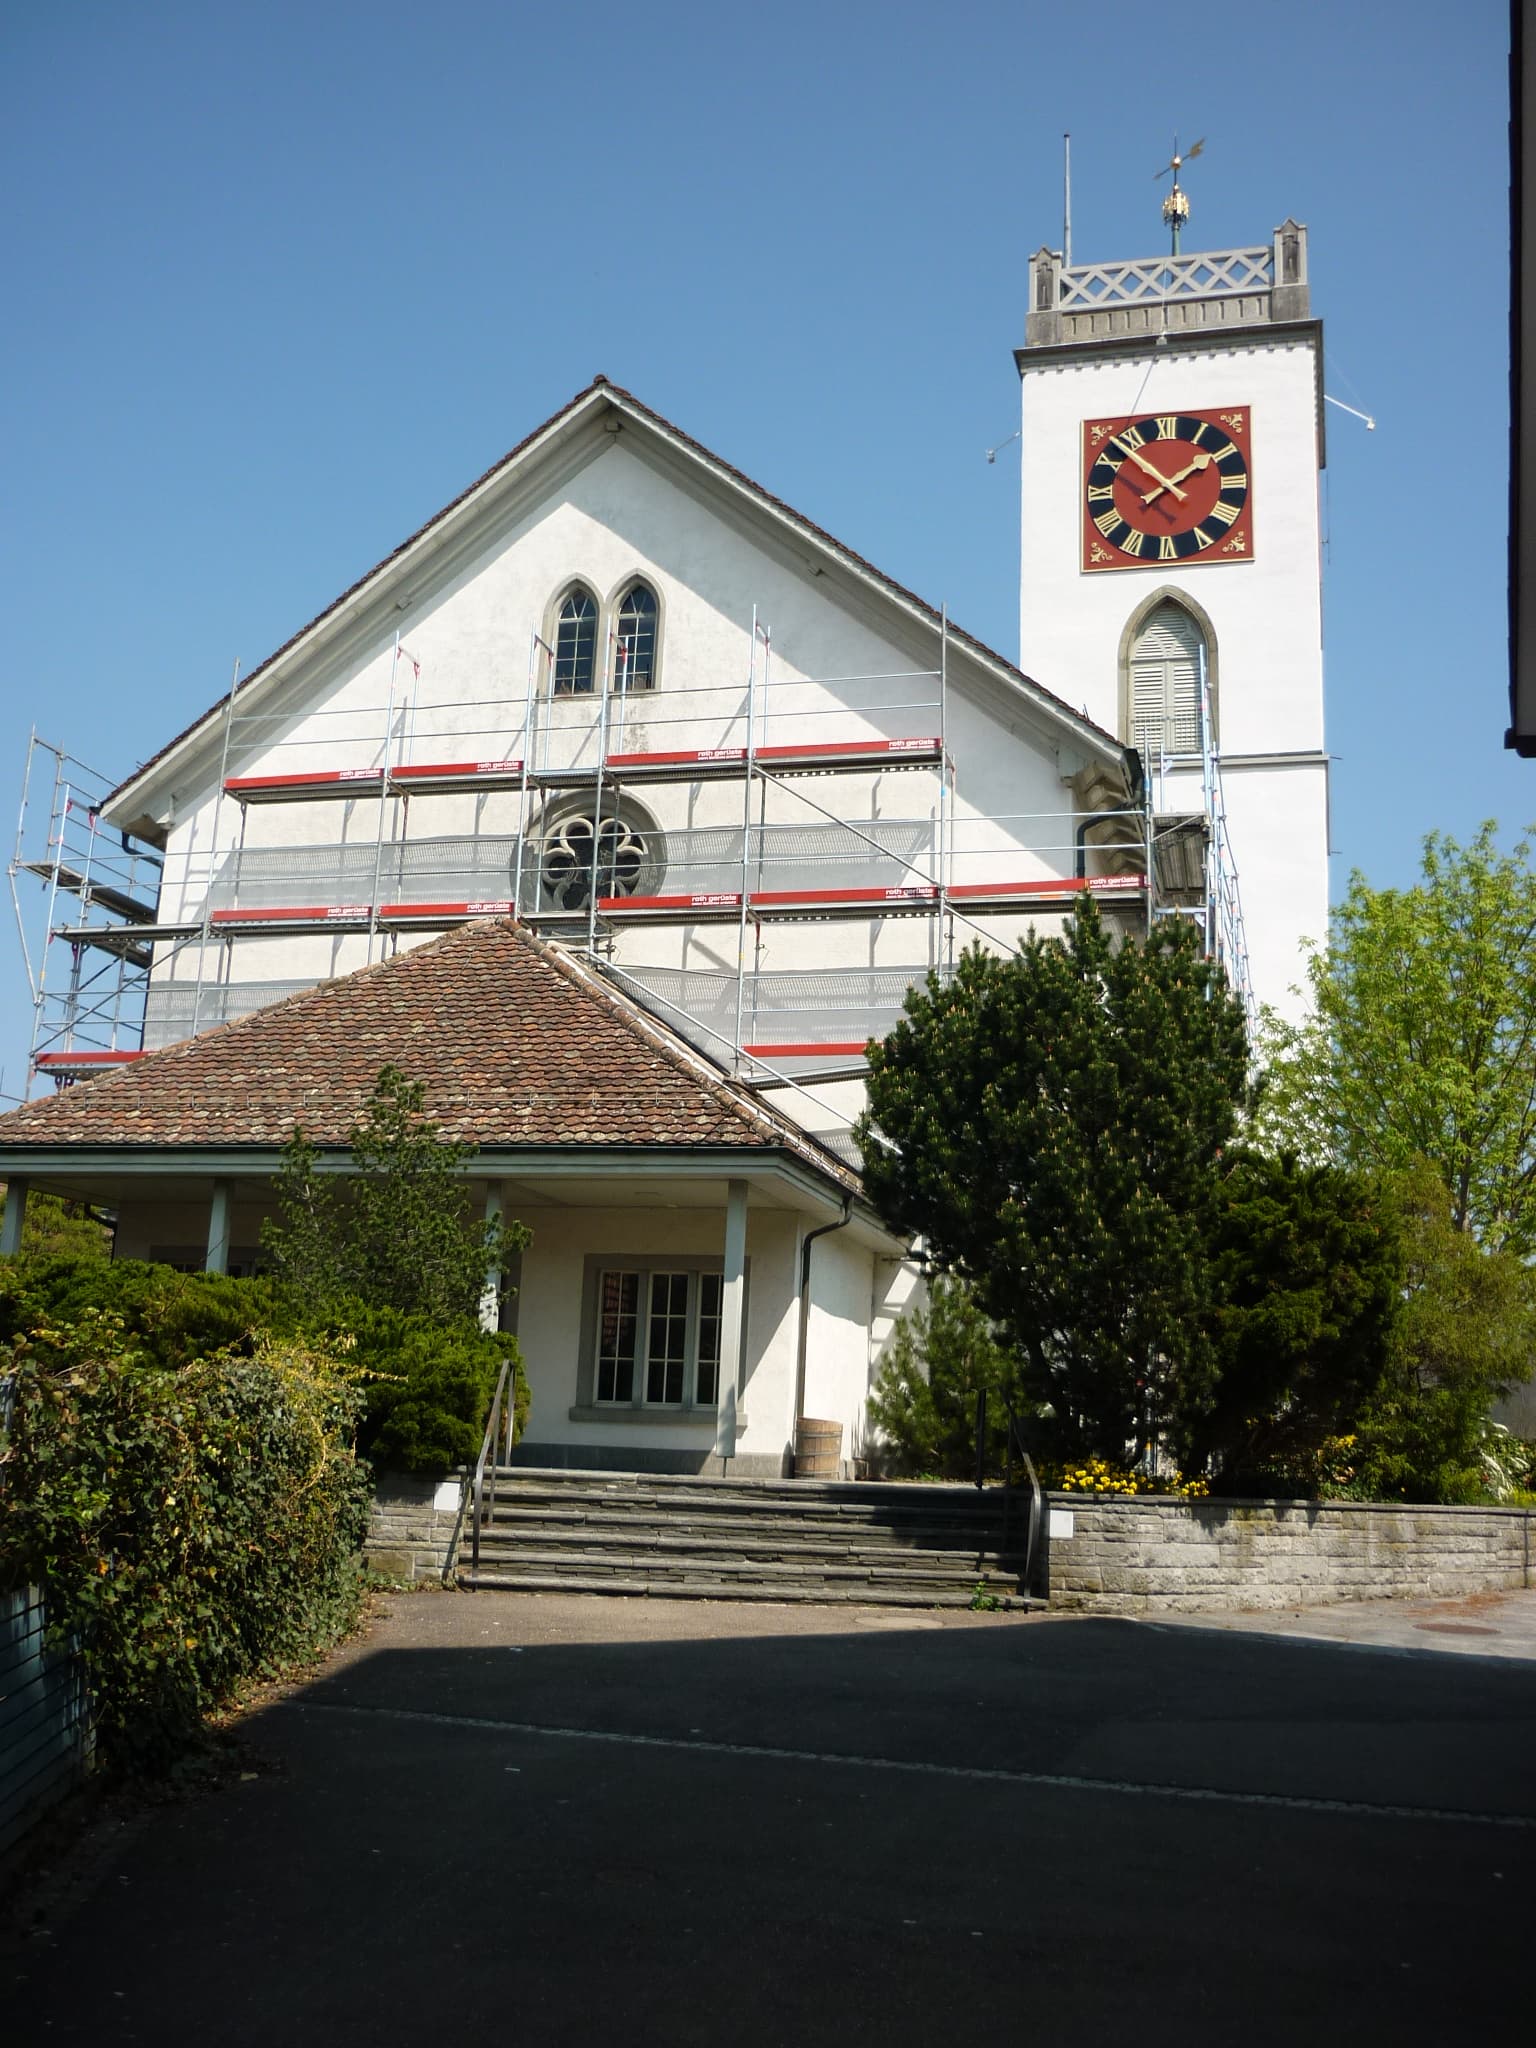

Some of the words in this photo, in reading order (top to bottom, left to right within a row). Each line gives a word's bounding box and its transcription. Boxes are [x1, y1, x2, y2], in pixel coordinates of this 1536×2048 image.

[1119, 426, 1146, 452] XI
[1154, 416, 1178, 441] XII
[1191, 421, 1209, 445] I
[1095, 452, 1124, 473] X
[1210, 442, 1238, 463] II
[1088, 484, 1113, 502] IX
[1220, 473, 1247, 490] III
[1093, 507, 1124, 538] VIII
[1208, 501, 1241, 527] IIII
[1119, 528, 1144, 557] VII
[1157, 535, 1179, 560] VI
[1193, 527, 1215, 551] V
